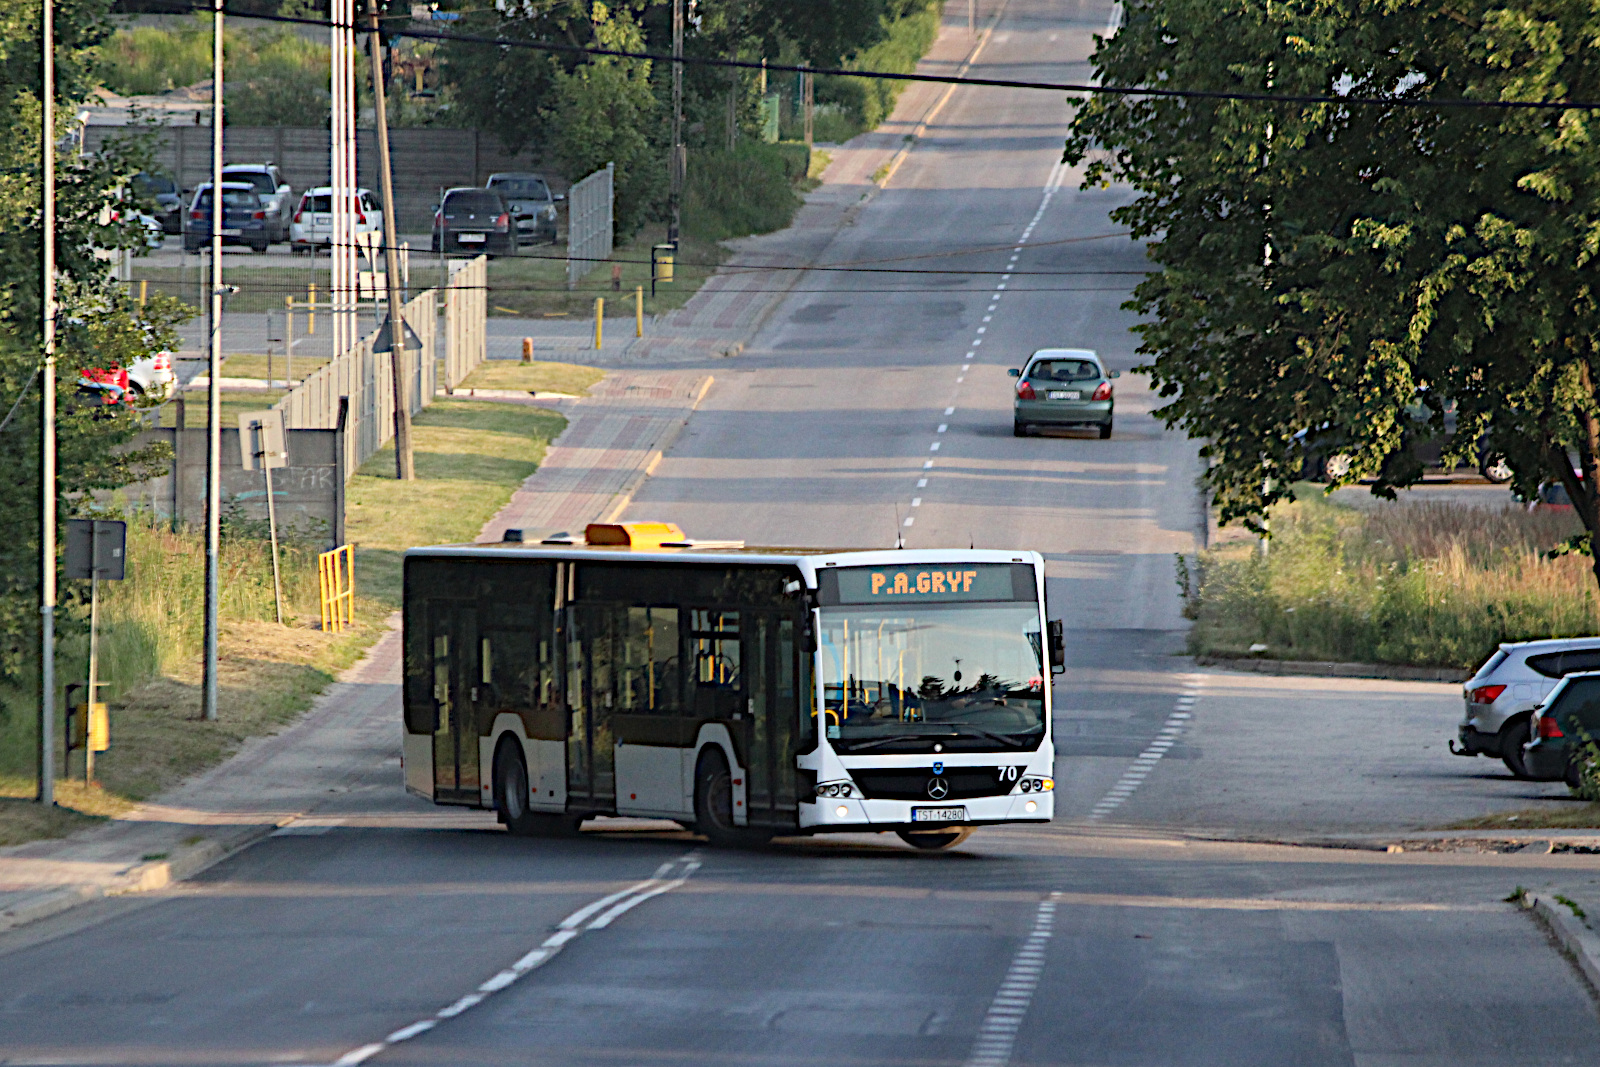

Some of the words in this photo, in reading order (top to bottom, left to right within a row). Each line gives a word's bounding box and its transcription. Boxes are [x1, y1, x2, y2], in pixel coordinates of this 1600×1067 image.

[871, 570, 977, 594] P.A.GRYF
[997, 766, 1017, 782] 70
[916, 810, 933, 820] TST
[936, 810, 963, 820] 14280
